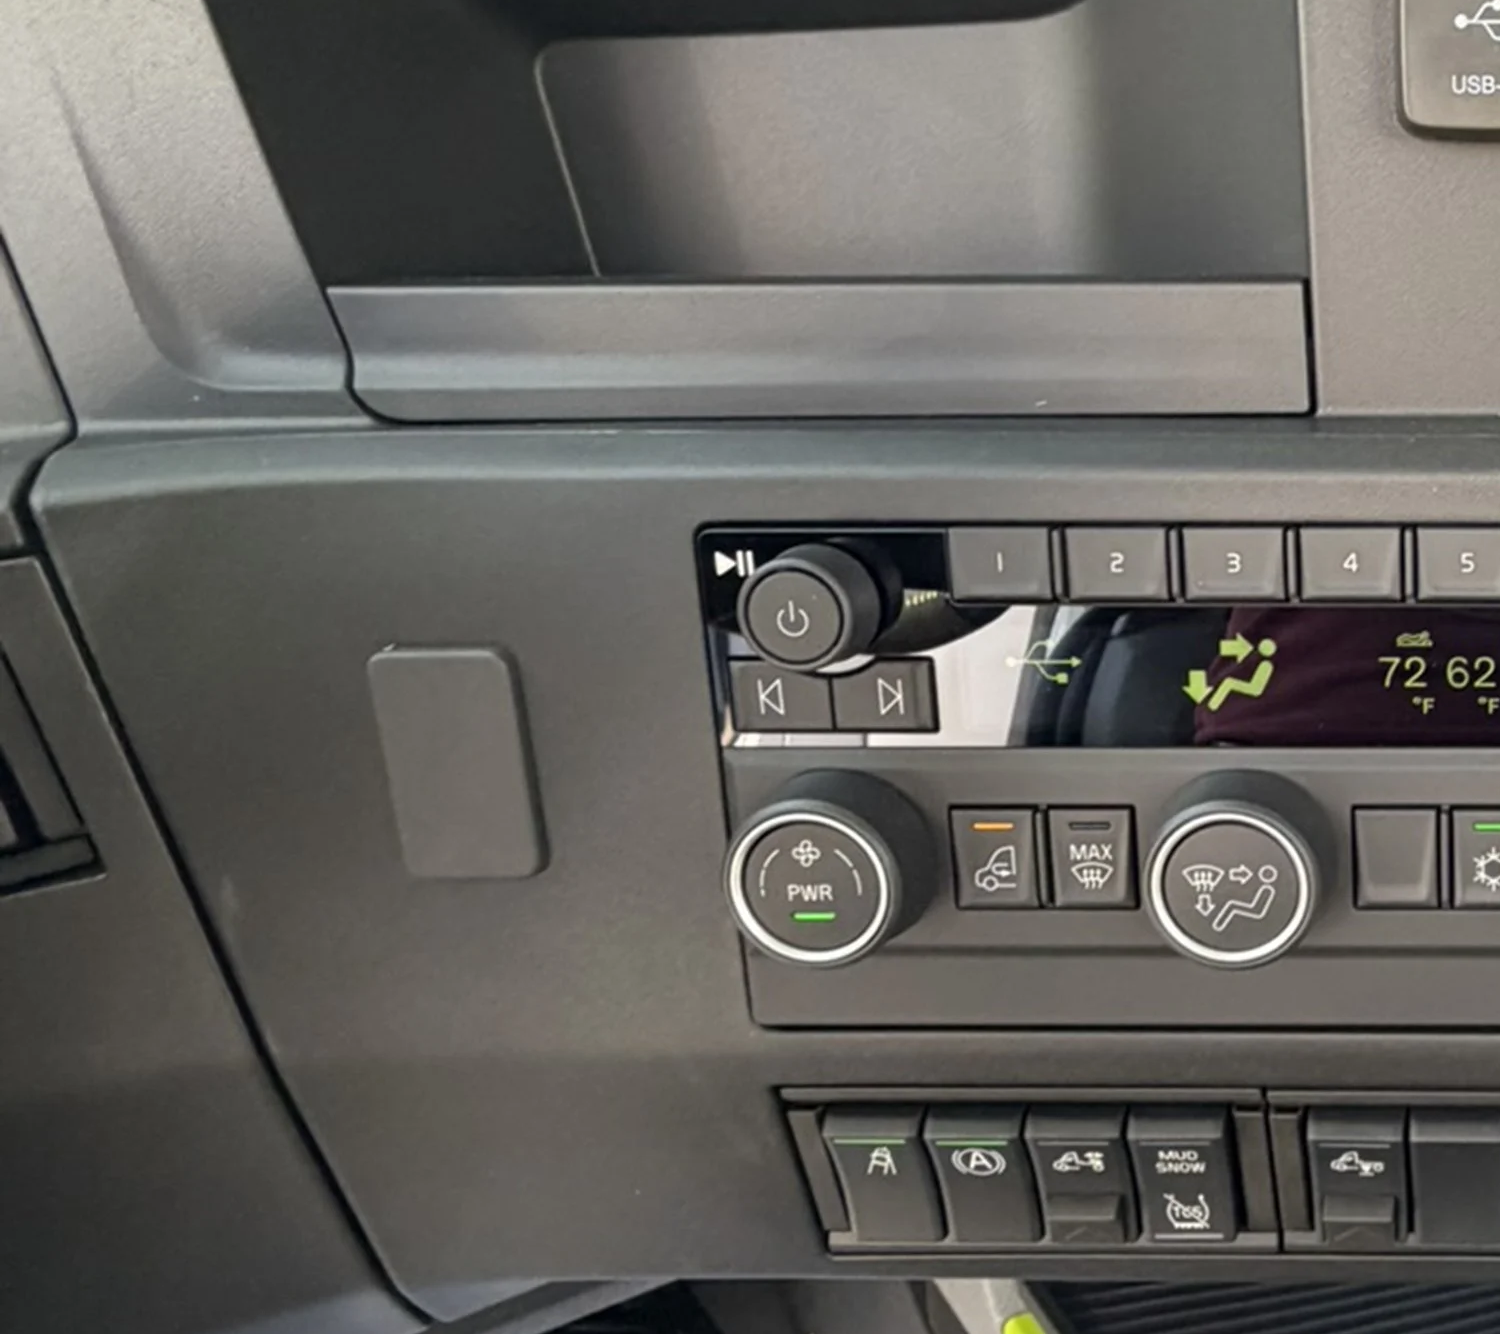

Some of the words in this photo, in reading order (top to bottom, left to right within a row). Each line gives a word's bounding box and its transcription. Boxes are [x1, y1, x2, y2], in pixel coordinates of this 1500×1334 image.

[1109, 552, 1125, 573] 2
[1227, 552, 1242, 573] 3
[1342, 552, 1360, 573] 4
[1459, 552, 1476, 573] 5
[1378, 656, 1427, 688] 72
[1446, 656, 1497, 688] 62
[1069, 842, 1114, 861] MAX
[787, 884, 834, 903] PWR
[1157, 1150, 1199, 1161] MUD
[1155, 1161, 1207, 1174] SNOW
